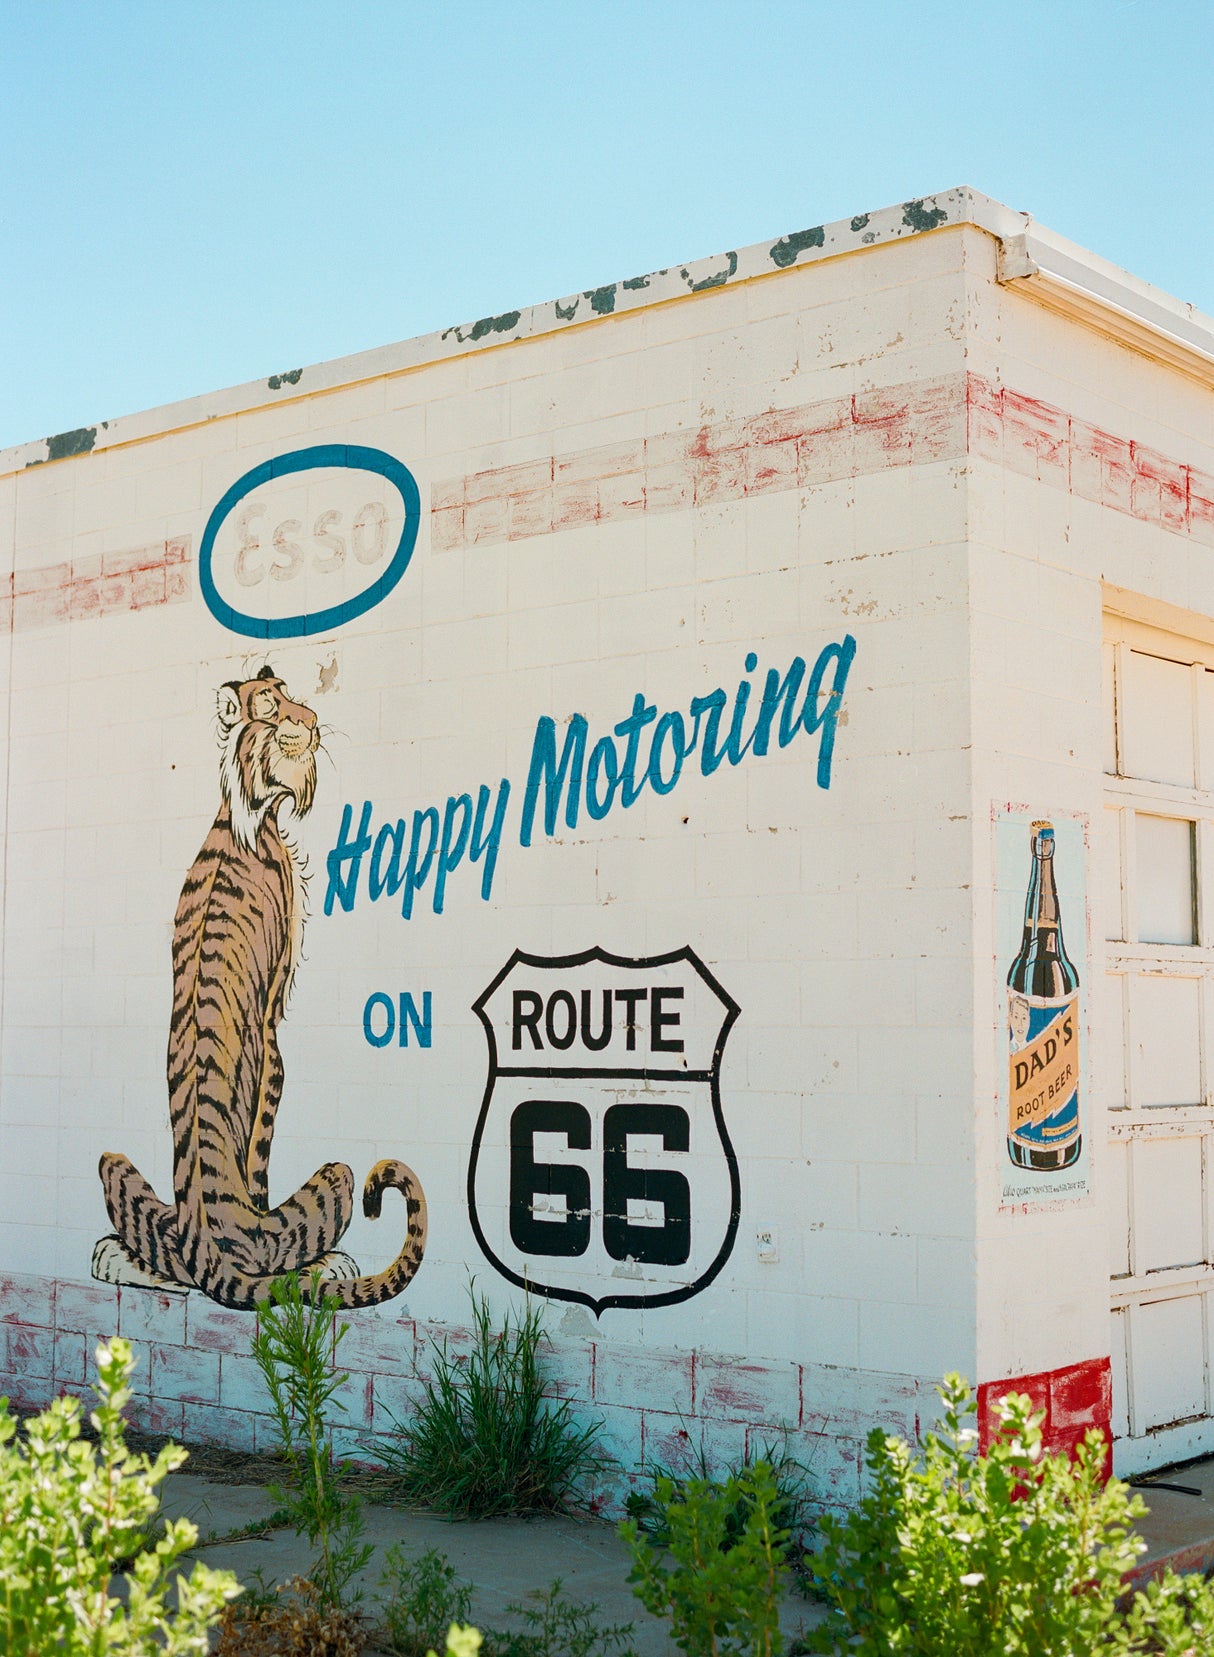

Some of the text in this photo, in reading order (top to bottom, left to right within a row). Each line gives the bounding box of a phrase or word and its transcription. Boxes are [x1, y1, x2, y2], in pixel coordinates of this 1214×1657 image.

[323, 633, 857, 920] Happy Motoring
[363, 991, 432, 1048] ON
[512, 987, 684, 1052] ROUTE
[1014, 1016, 1073, 1090] DAD'S
[1016, 1063, 1073, 1120] ROOT BEER
[509, 1100, 691, 1265] 66
